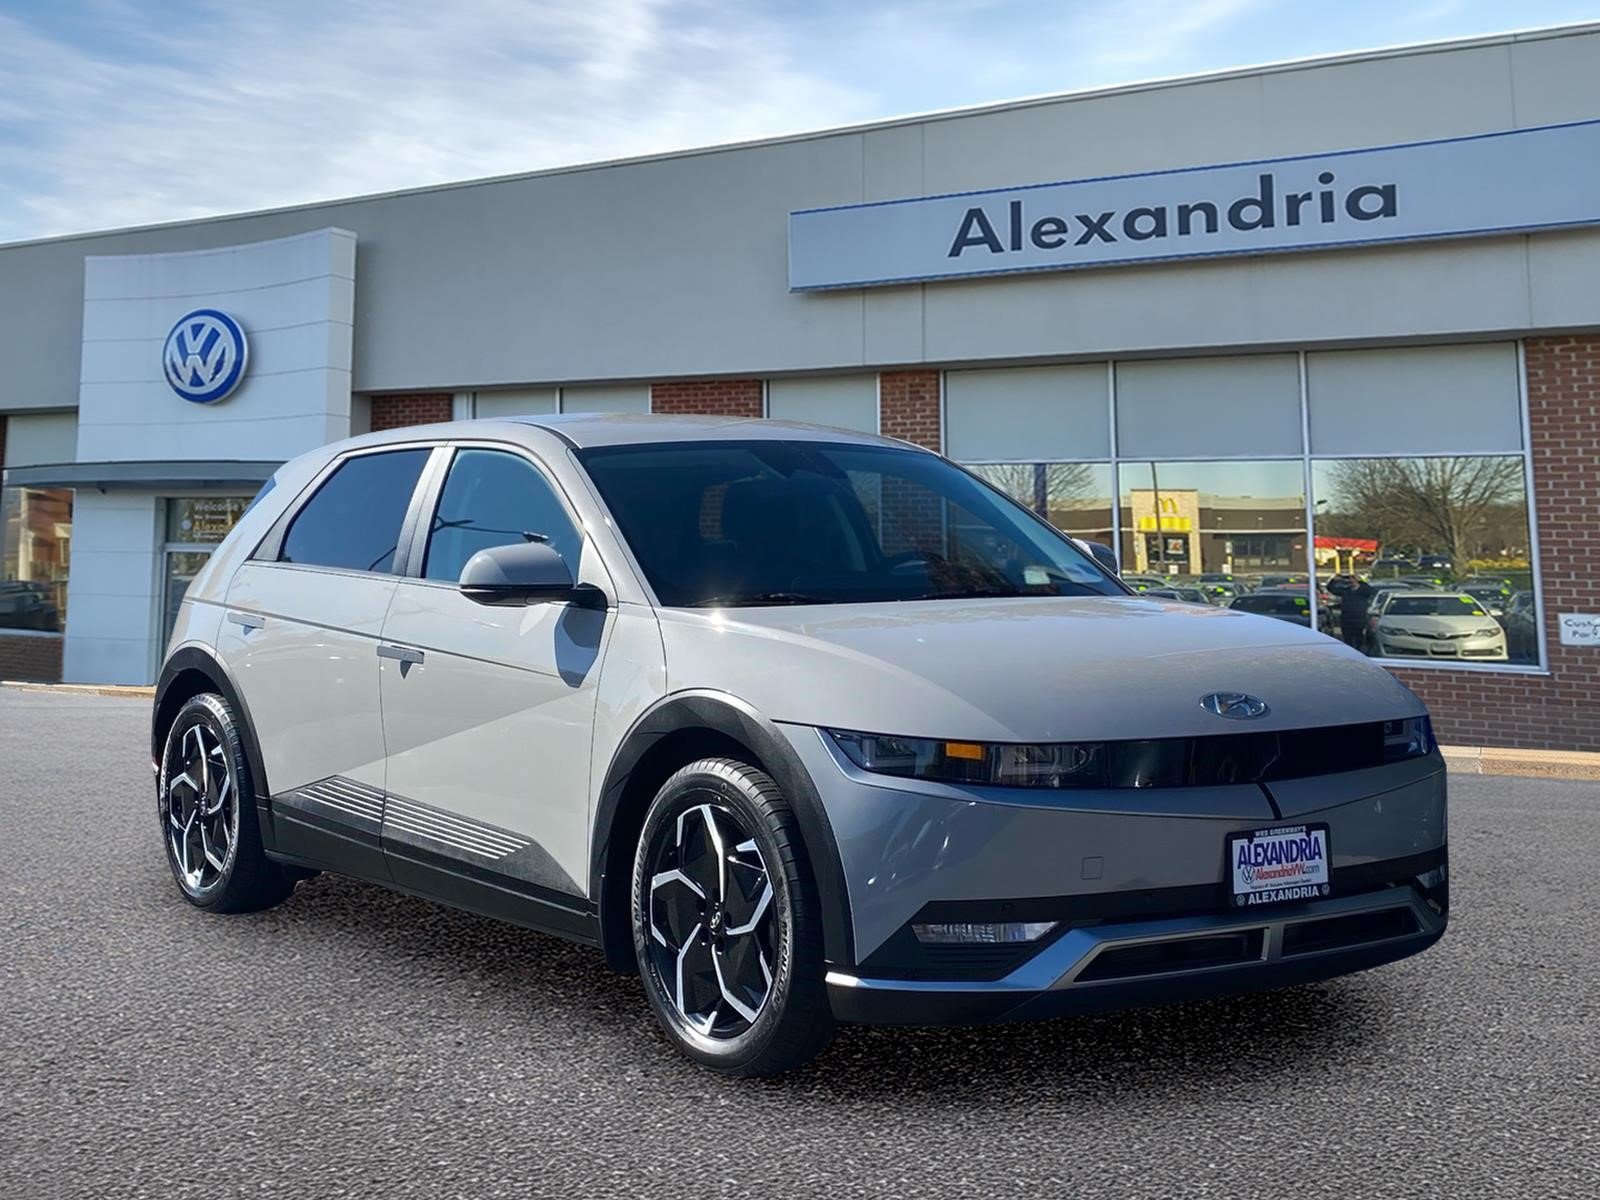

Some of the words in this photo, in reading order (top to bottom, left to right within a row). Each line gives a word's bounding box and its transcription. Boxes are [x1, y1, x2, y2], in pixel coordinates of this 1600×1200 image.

[947, 171, 1398, 257] Alexandria
[1237, 836, 1322, 869] ALEXANDRIA
[1248, 885, 1319, 905] ALEXANDRIA
